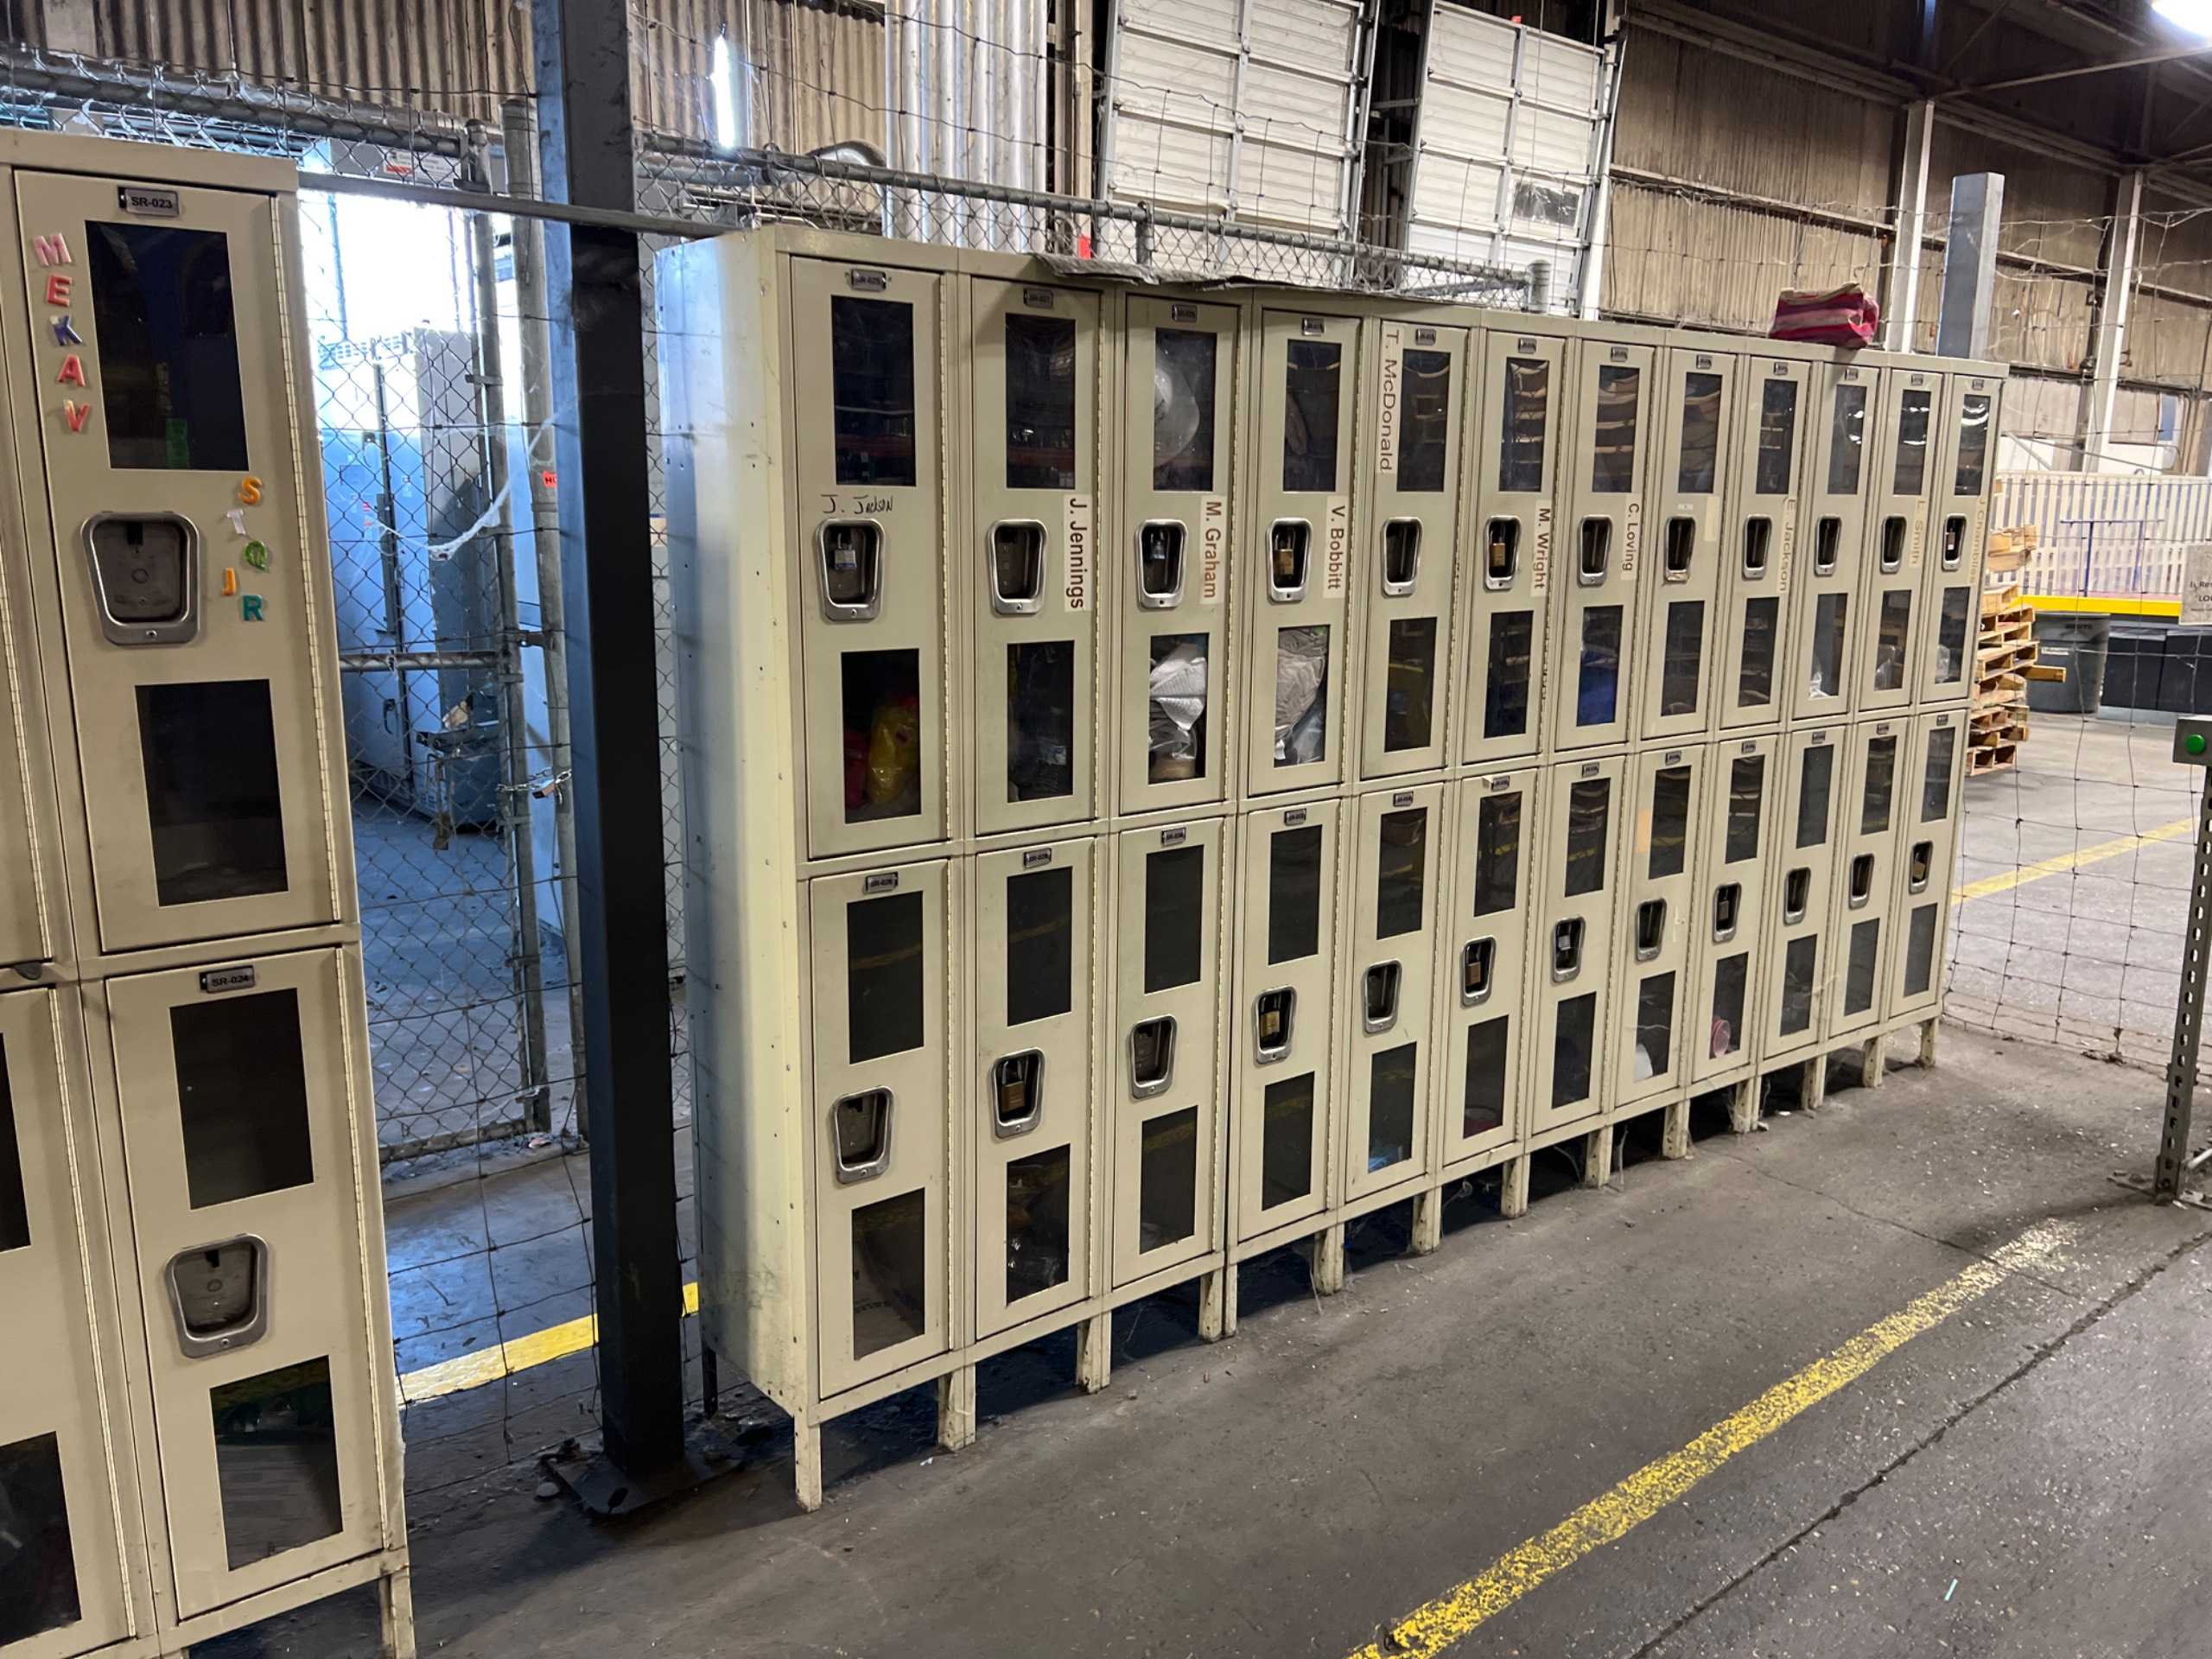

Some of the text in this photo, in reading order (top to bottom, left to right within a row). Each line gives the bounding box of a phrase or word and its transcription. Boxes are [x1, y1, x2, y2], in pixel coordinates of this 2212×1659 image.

[130, 195, 173, 209] SR-023
[1380, 329, 1400, 472] T. McDonald
[1065, 498, 1087, 608] J. Jennings
[1204, 501, 1222, 598] M. Graham
[1327, 505, 1346, 590] V. Bobbitt
[1533, 507, 1552, 589] M. Wright
[1622, 503, 1640, 571] C. Loving
[1780, 521, 1794, 591] Jackson
[1911, 519, 1923, 565] Smith
